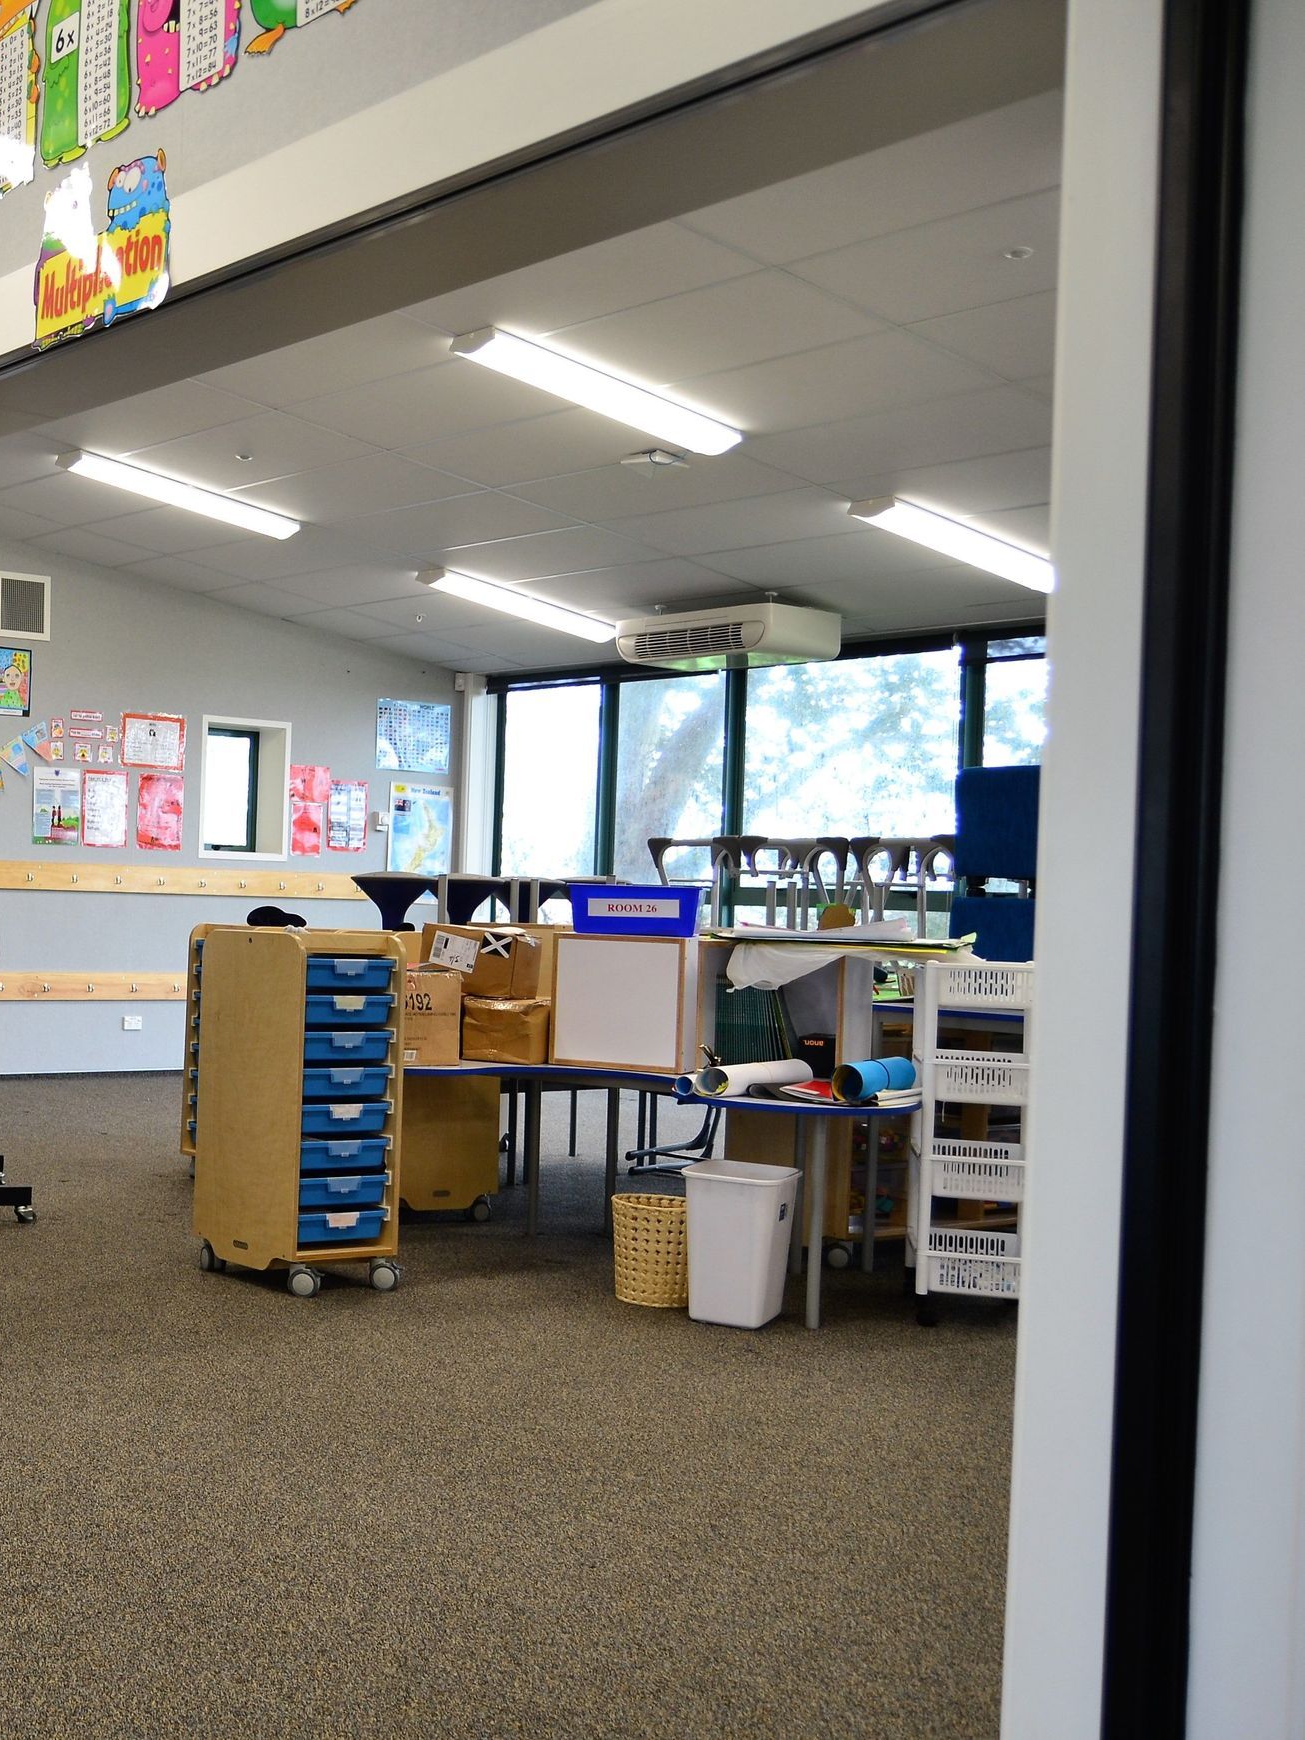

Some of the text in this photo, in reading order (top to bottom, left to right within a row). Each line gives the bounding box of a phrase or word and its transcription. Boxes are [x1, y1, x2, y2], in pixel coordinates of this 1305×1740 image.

[56, 29, 74, 53] 6x
[607, 904, 657, 912] ROOM 26
